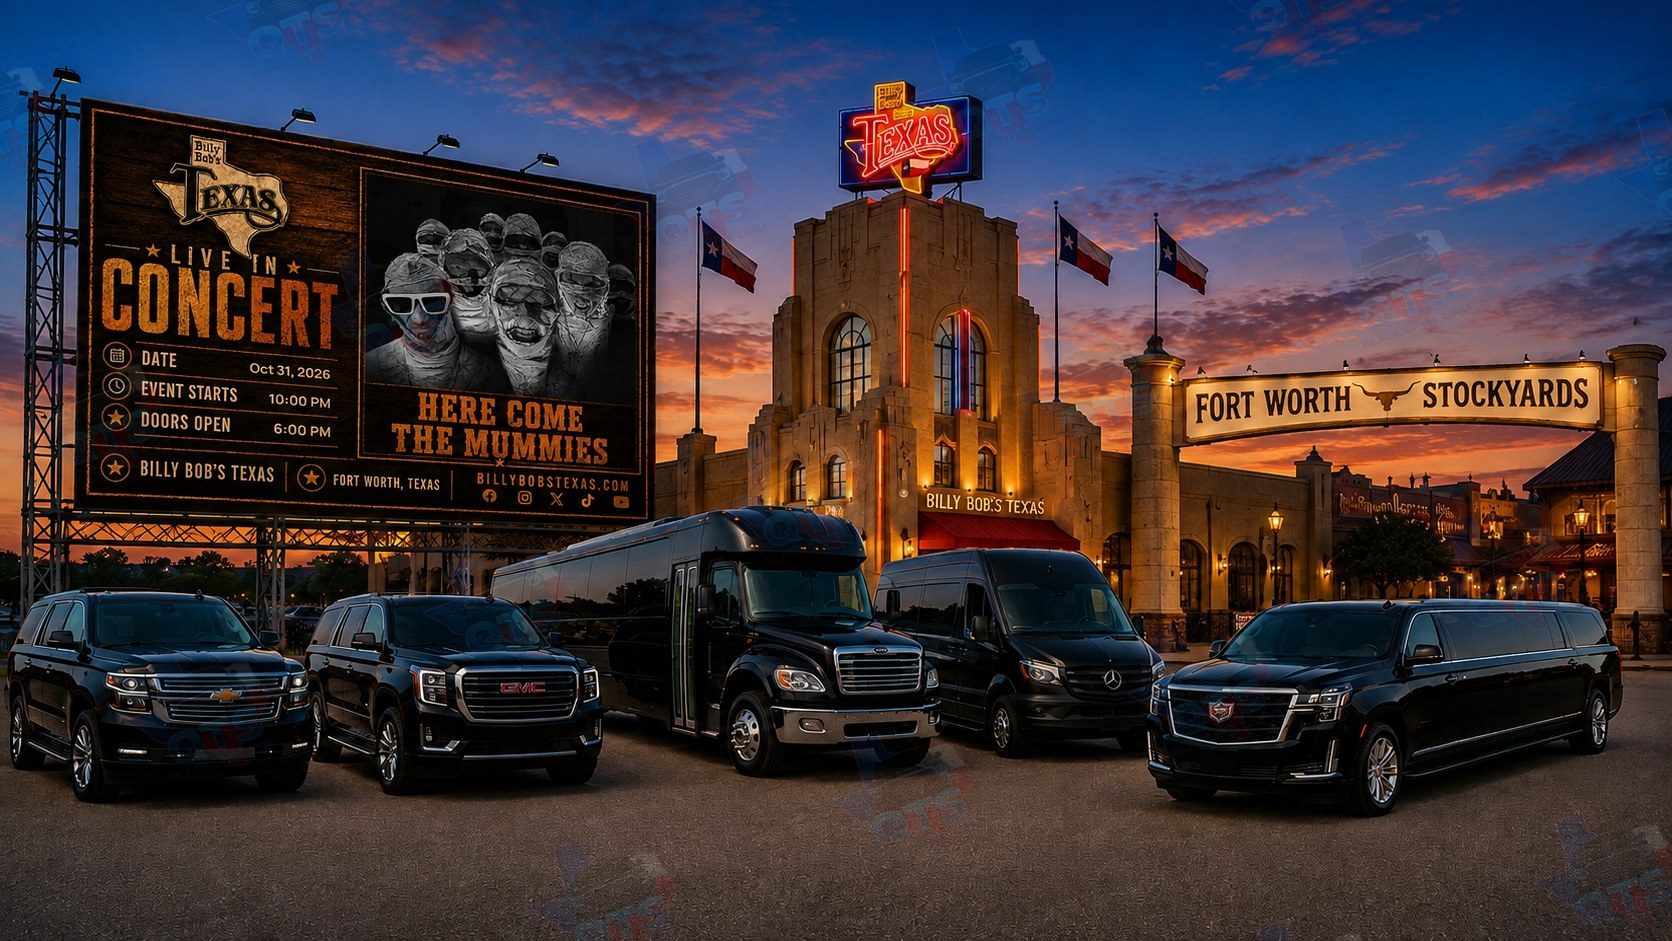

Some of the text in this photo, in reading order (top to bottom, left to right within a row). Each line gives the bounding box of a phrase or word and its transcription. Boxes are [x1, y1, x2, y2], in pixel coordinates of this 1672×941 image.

[194, 140, 221, 155] Billy
[194, 152, 222, 165] Bob's
[852, 113, 956, 178] TEXAS
[169, 162, 285, 228] TEXAS
[171, 244, 277, 275] LIVE IN
[102, 257, 338, 350] CONCERT
[142, 350, 331, 380] DATE Oct 31, 2026
[141, 380, 331, 409] EVENT STARTS 10:00 PM
[1195, 377, 1589, 424] FORT WORTH STOCKYARDS
[141, 411, 331, 438] DOORS OPEN 6:00 PM
[417, 391, 583, 432] HERE COME
[391, 423, 608, 465] THE MUMMIES
[140, 459, 274, 483] BILLY BOB'S TEXAS
[333, 473, 440, 491] FORT WORTH, TEXAS
[477, 472, 630, 493] BILLYBOBSTEXAS.COM
[926, 492, 961, 510] BILLY
[1005, 499, 1045, 515] TEXAS
[500, 681, 546, 694] GMC
